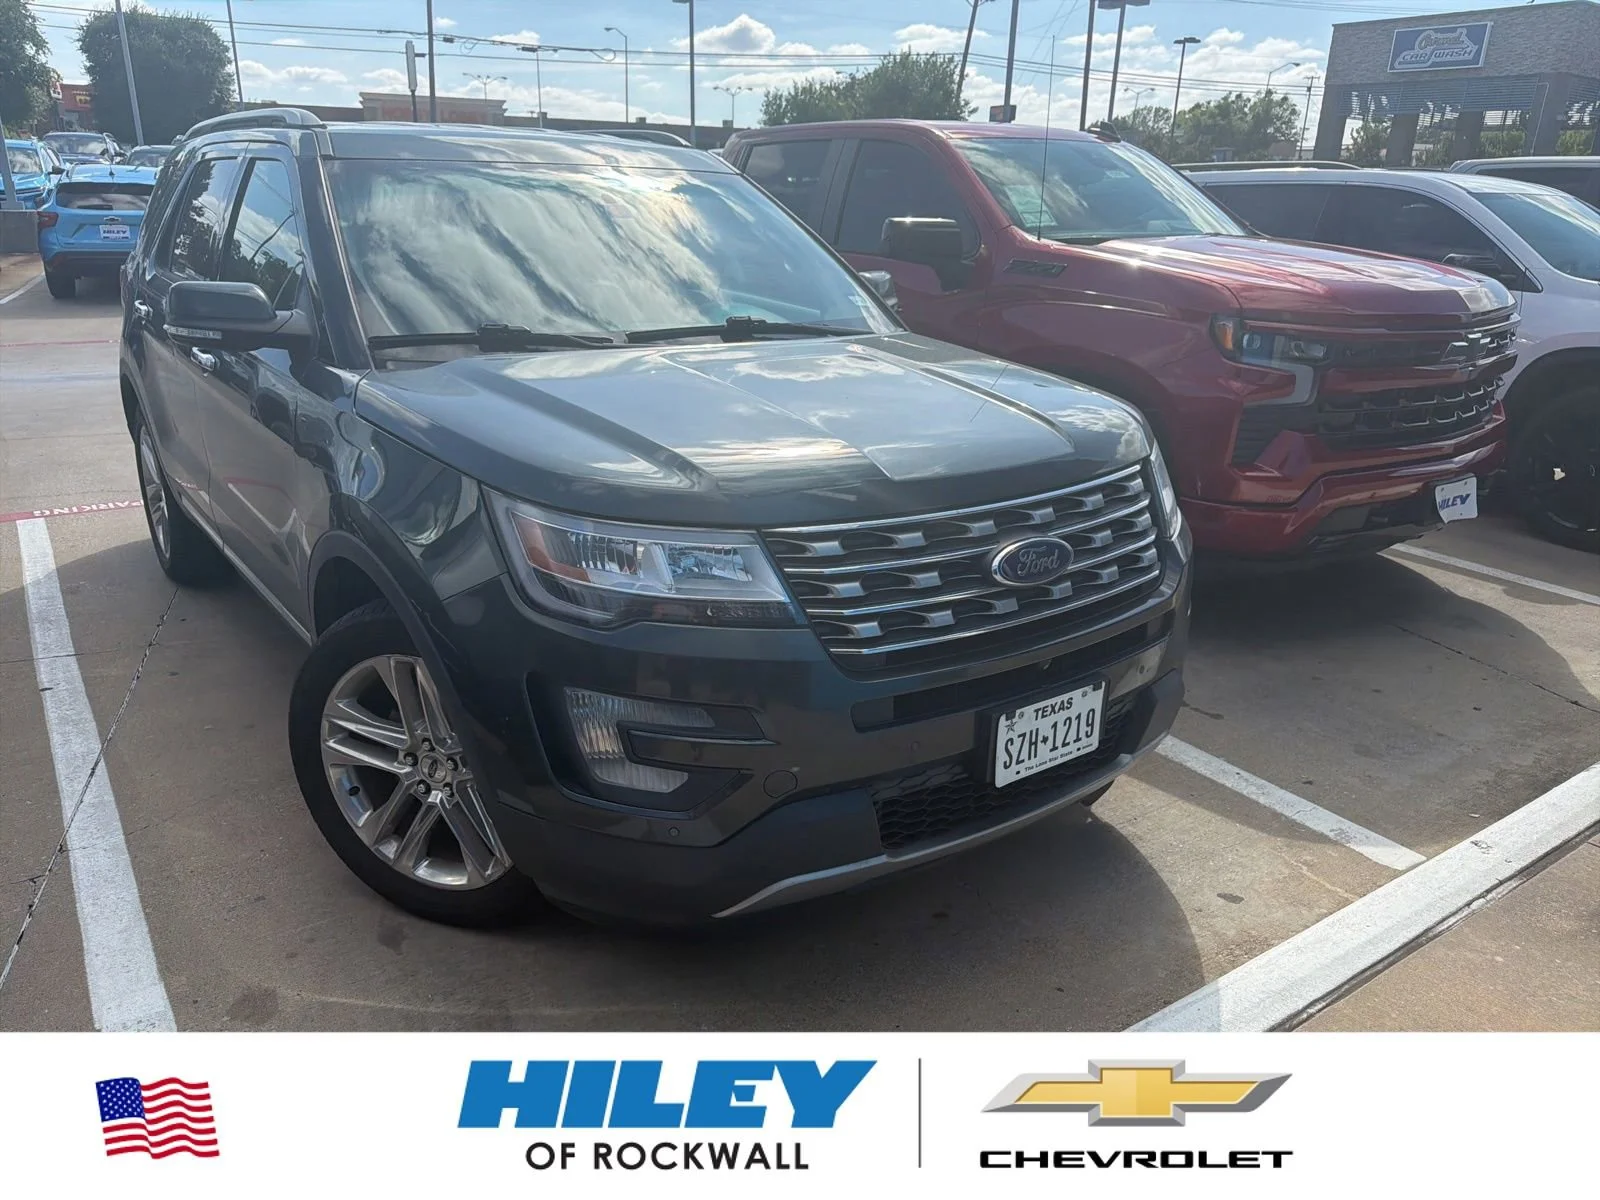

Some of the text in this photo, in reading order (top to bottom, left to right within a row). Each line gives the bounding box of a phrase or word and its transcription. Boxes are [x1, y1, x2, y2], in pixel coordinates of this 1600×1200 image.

[1402, 49, 1473, 61] CAR WASH
[32, 499, 144, 517] PARKING
[1438, 493, 1471, 511] HILEY
[1017, 545, 1060, 576] Ford
[1033, 697, 1073, 721] TEXAS
[1035, 760, 1048, 768] Lone
